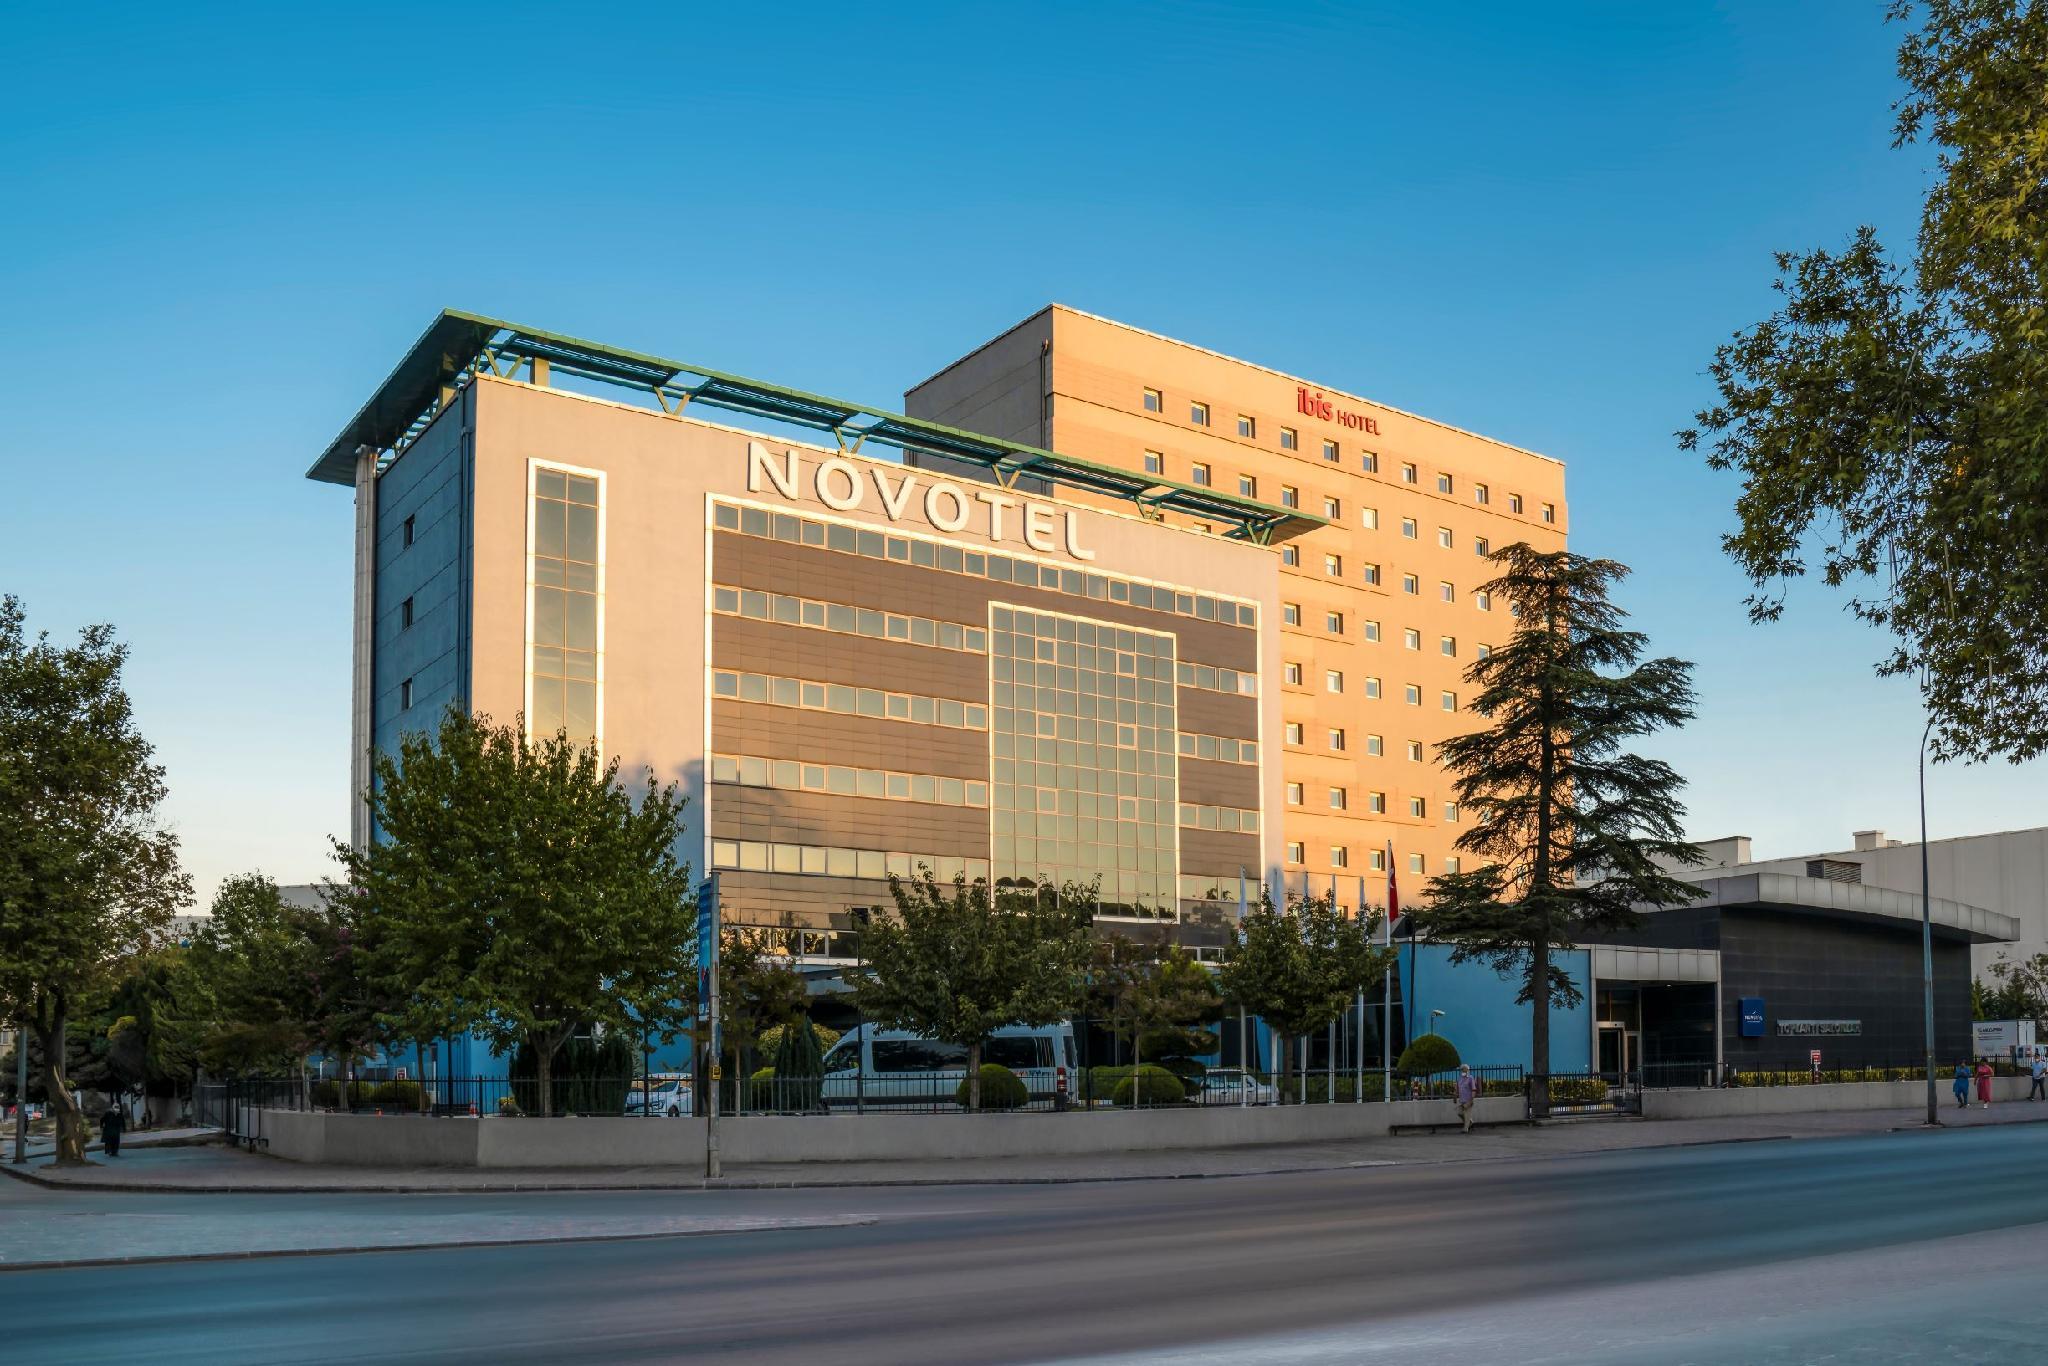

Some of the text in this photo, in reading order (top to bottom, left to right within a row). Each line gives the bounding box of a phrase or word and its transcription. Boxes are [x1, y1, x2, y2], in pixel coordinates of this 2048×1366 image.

[1297, 386, 1381, 435] ibis HOTEL
[747, 440, 1095, 561] NOVOTEL
